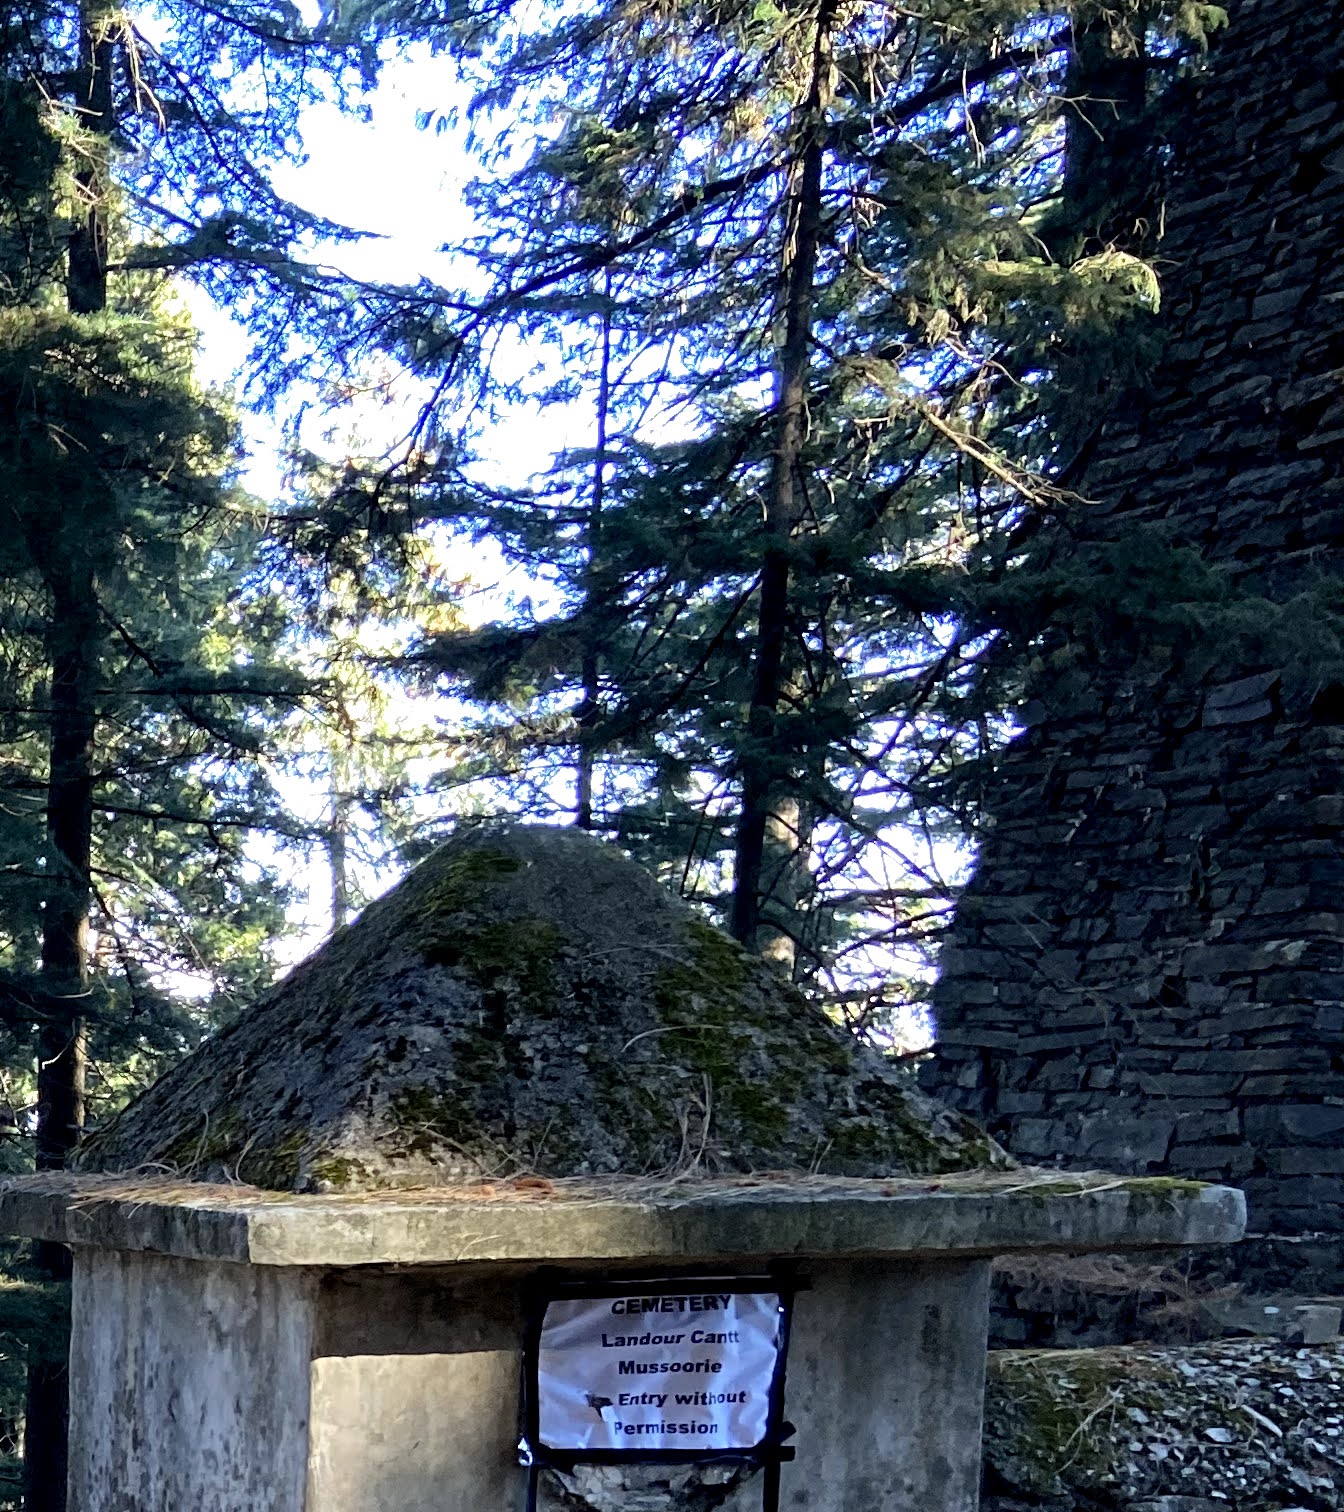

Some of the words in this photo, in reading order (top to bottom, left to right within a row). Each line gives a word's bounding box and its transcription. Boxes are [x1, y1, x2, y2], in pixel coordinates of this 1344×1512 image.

[611, 1294, 732, 1315] CEMETERY
[601, 1332, 686, 1348] Landour
[690, 1329, 741, 1344] Cantt
[618, 1358, 723, 1375] Mussoorie
[618, 1391, 669, 1408] Entry
[674, 1390, 747, 1406] without
[614, 1419, 719, 1436] Permission
